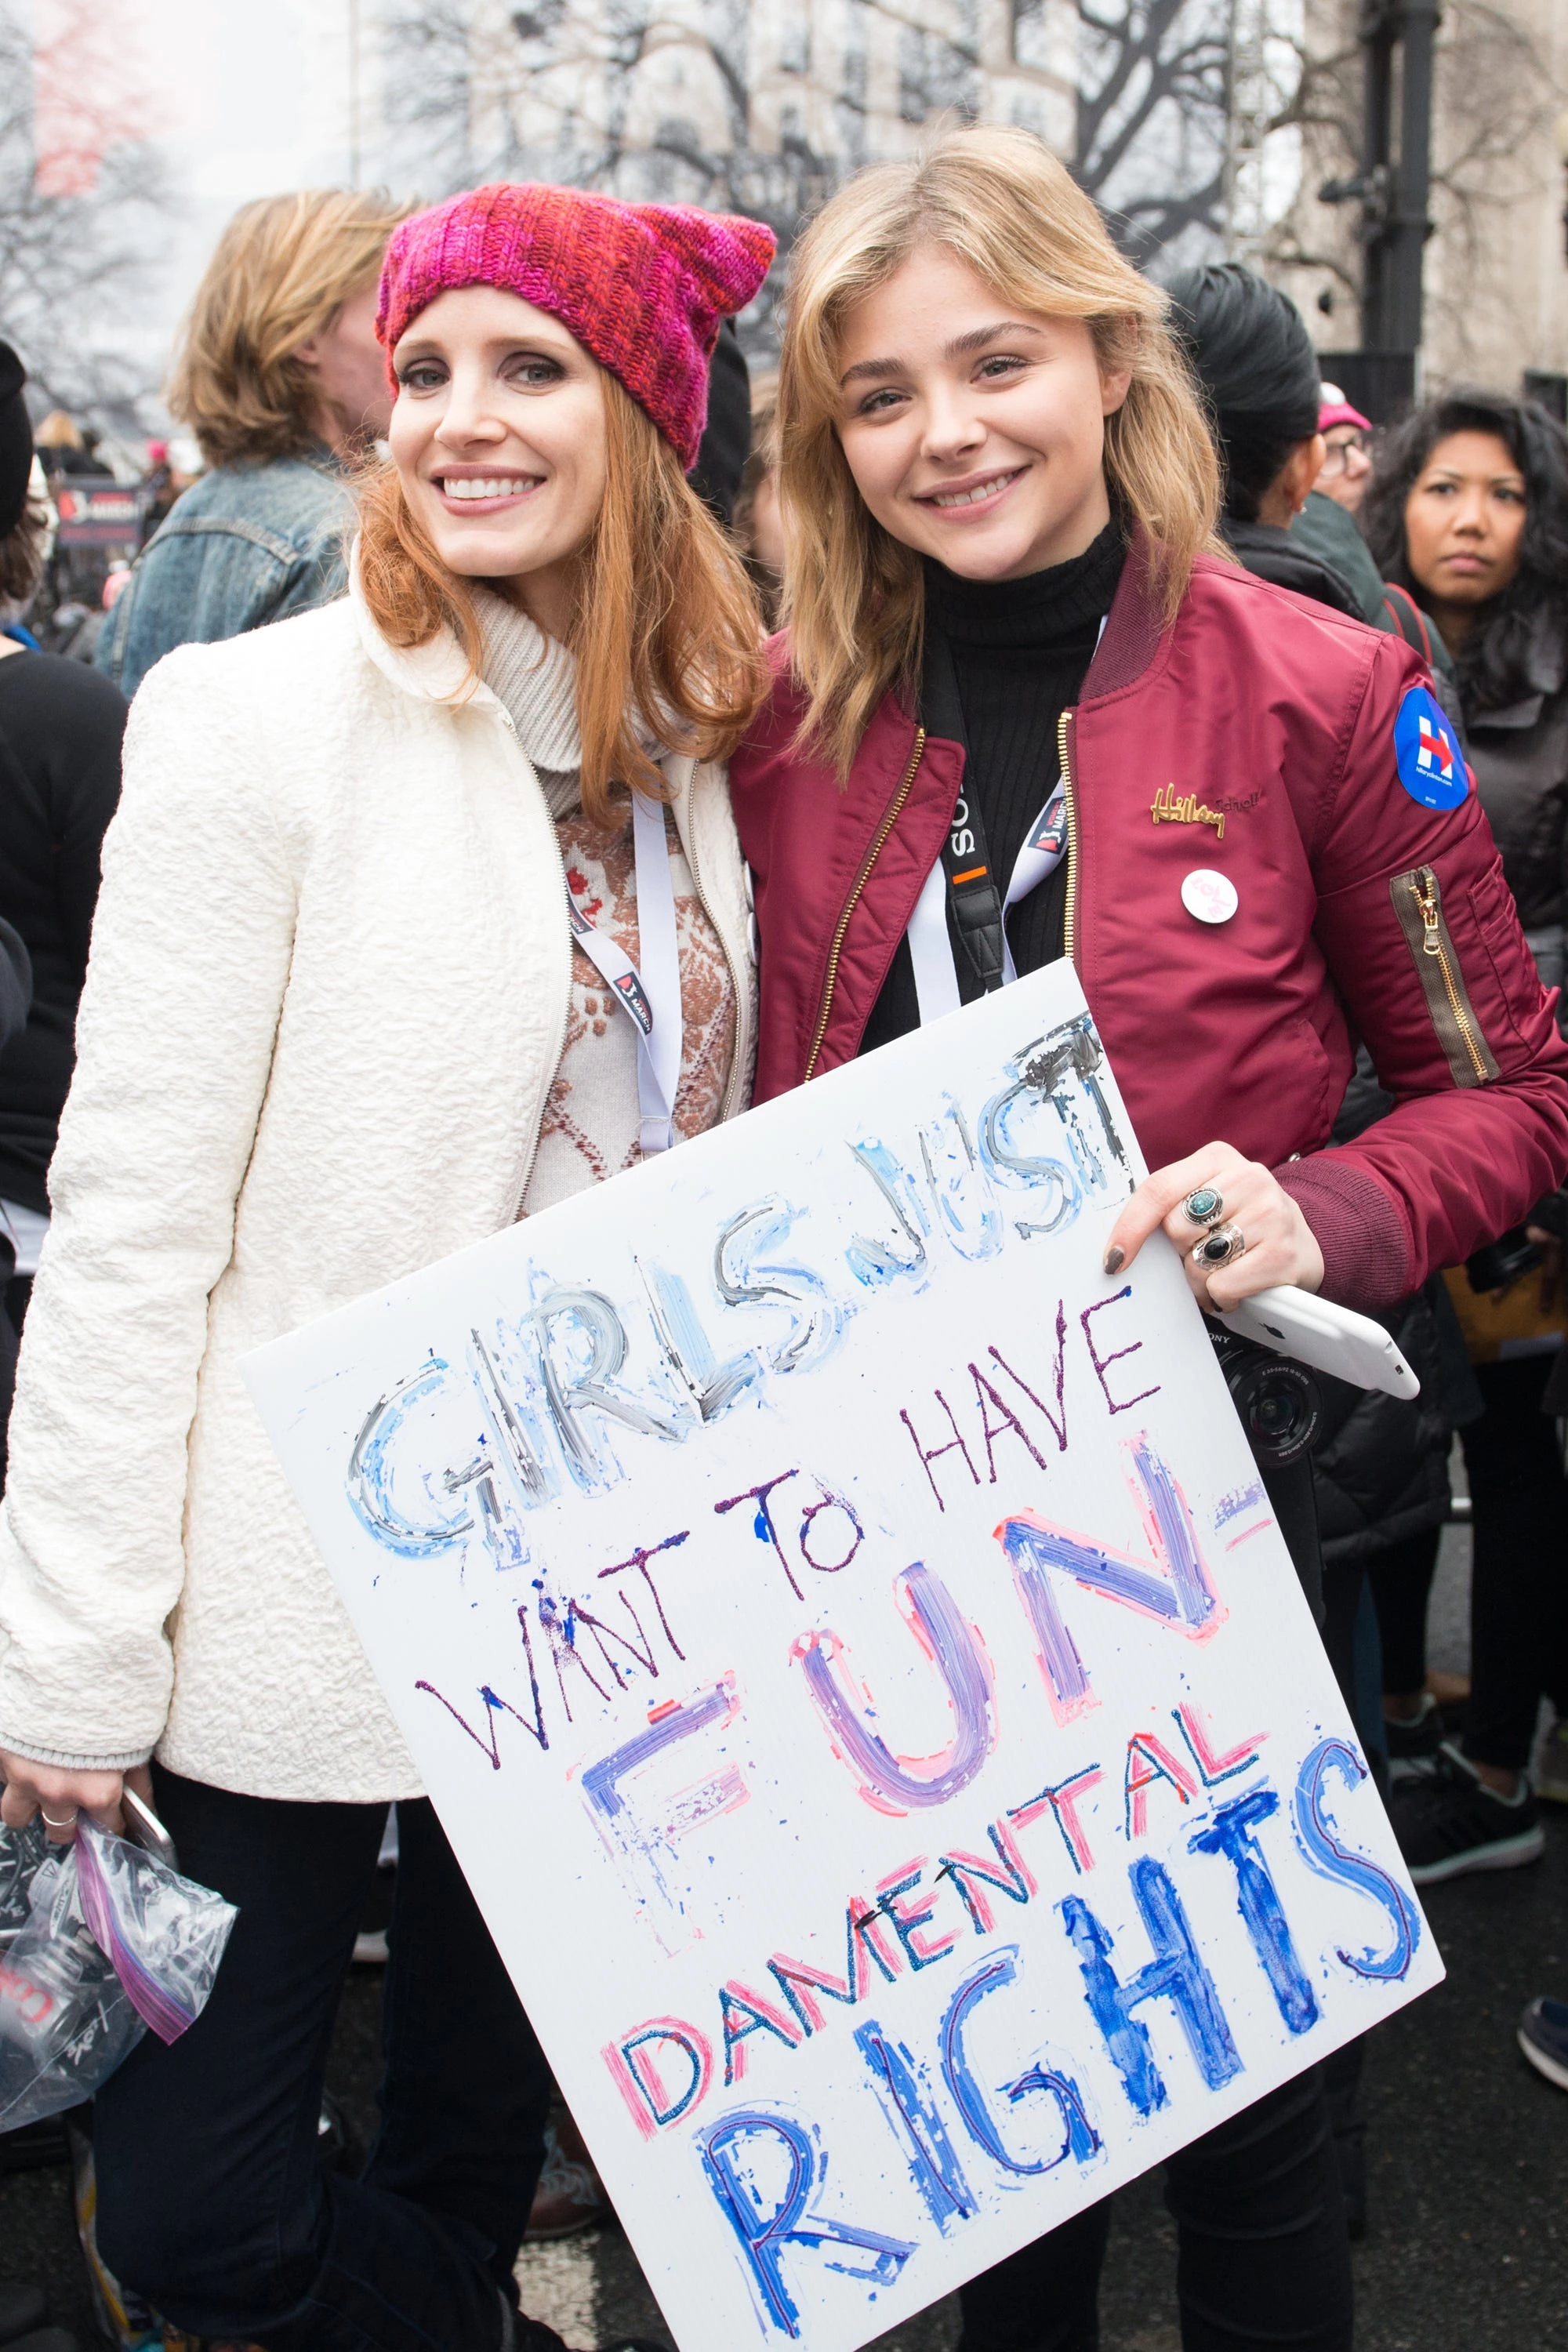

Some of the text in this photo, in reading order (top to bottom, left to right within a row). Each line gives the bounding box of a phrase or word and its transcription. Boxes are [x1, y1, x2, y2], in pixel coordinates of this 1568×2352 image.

[631, 998, 651, 1032] MARCH
[951, 784, 975, 857] SO
[344, 1008, 1135, 1573] GIRLS JUST
[1208, 1332, 1231, 1344] ONY
[415, 1284, 1163, 1770] WANT TO HAVE
[600, 1700, 1271, 2143] DAMENTAL
[691, 1735, 1421, 2344] RIGHTS
